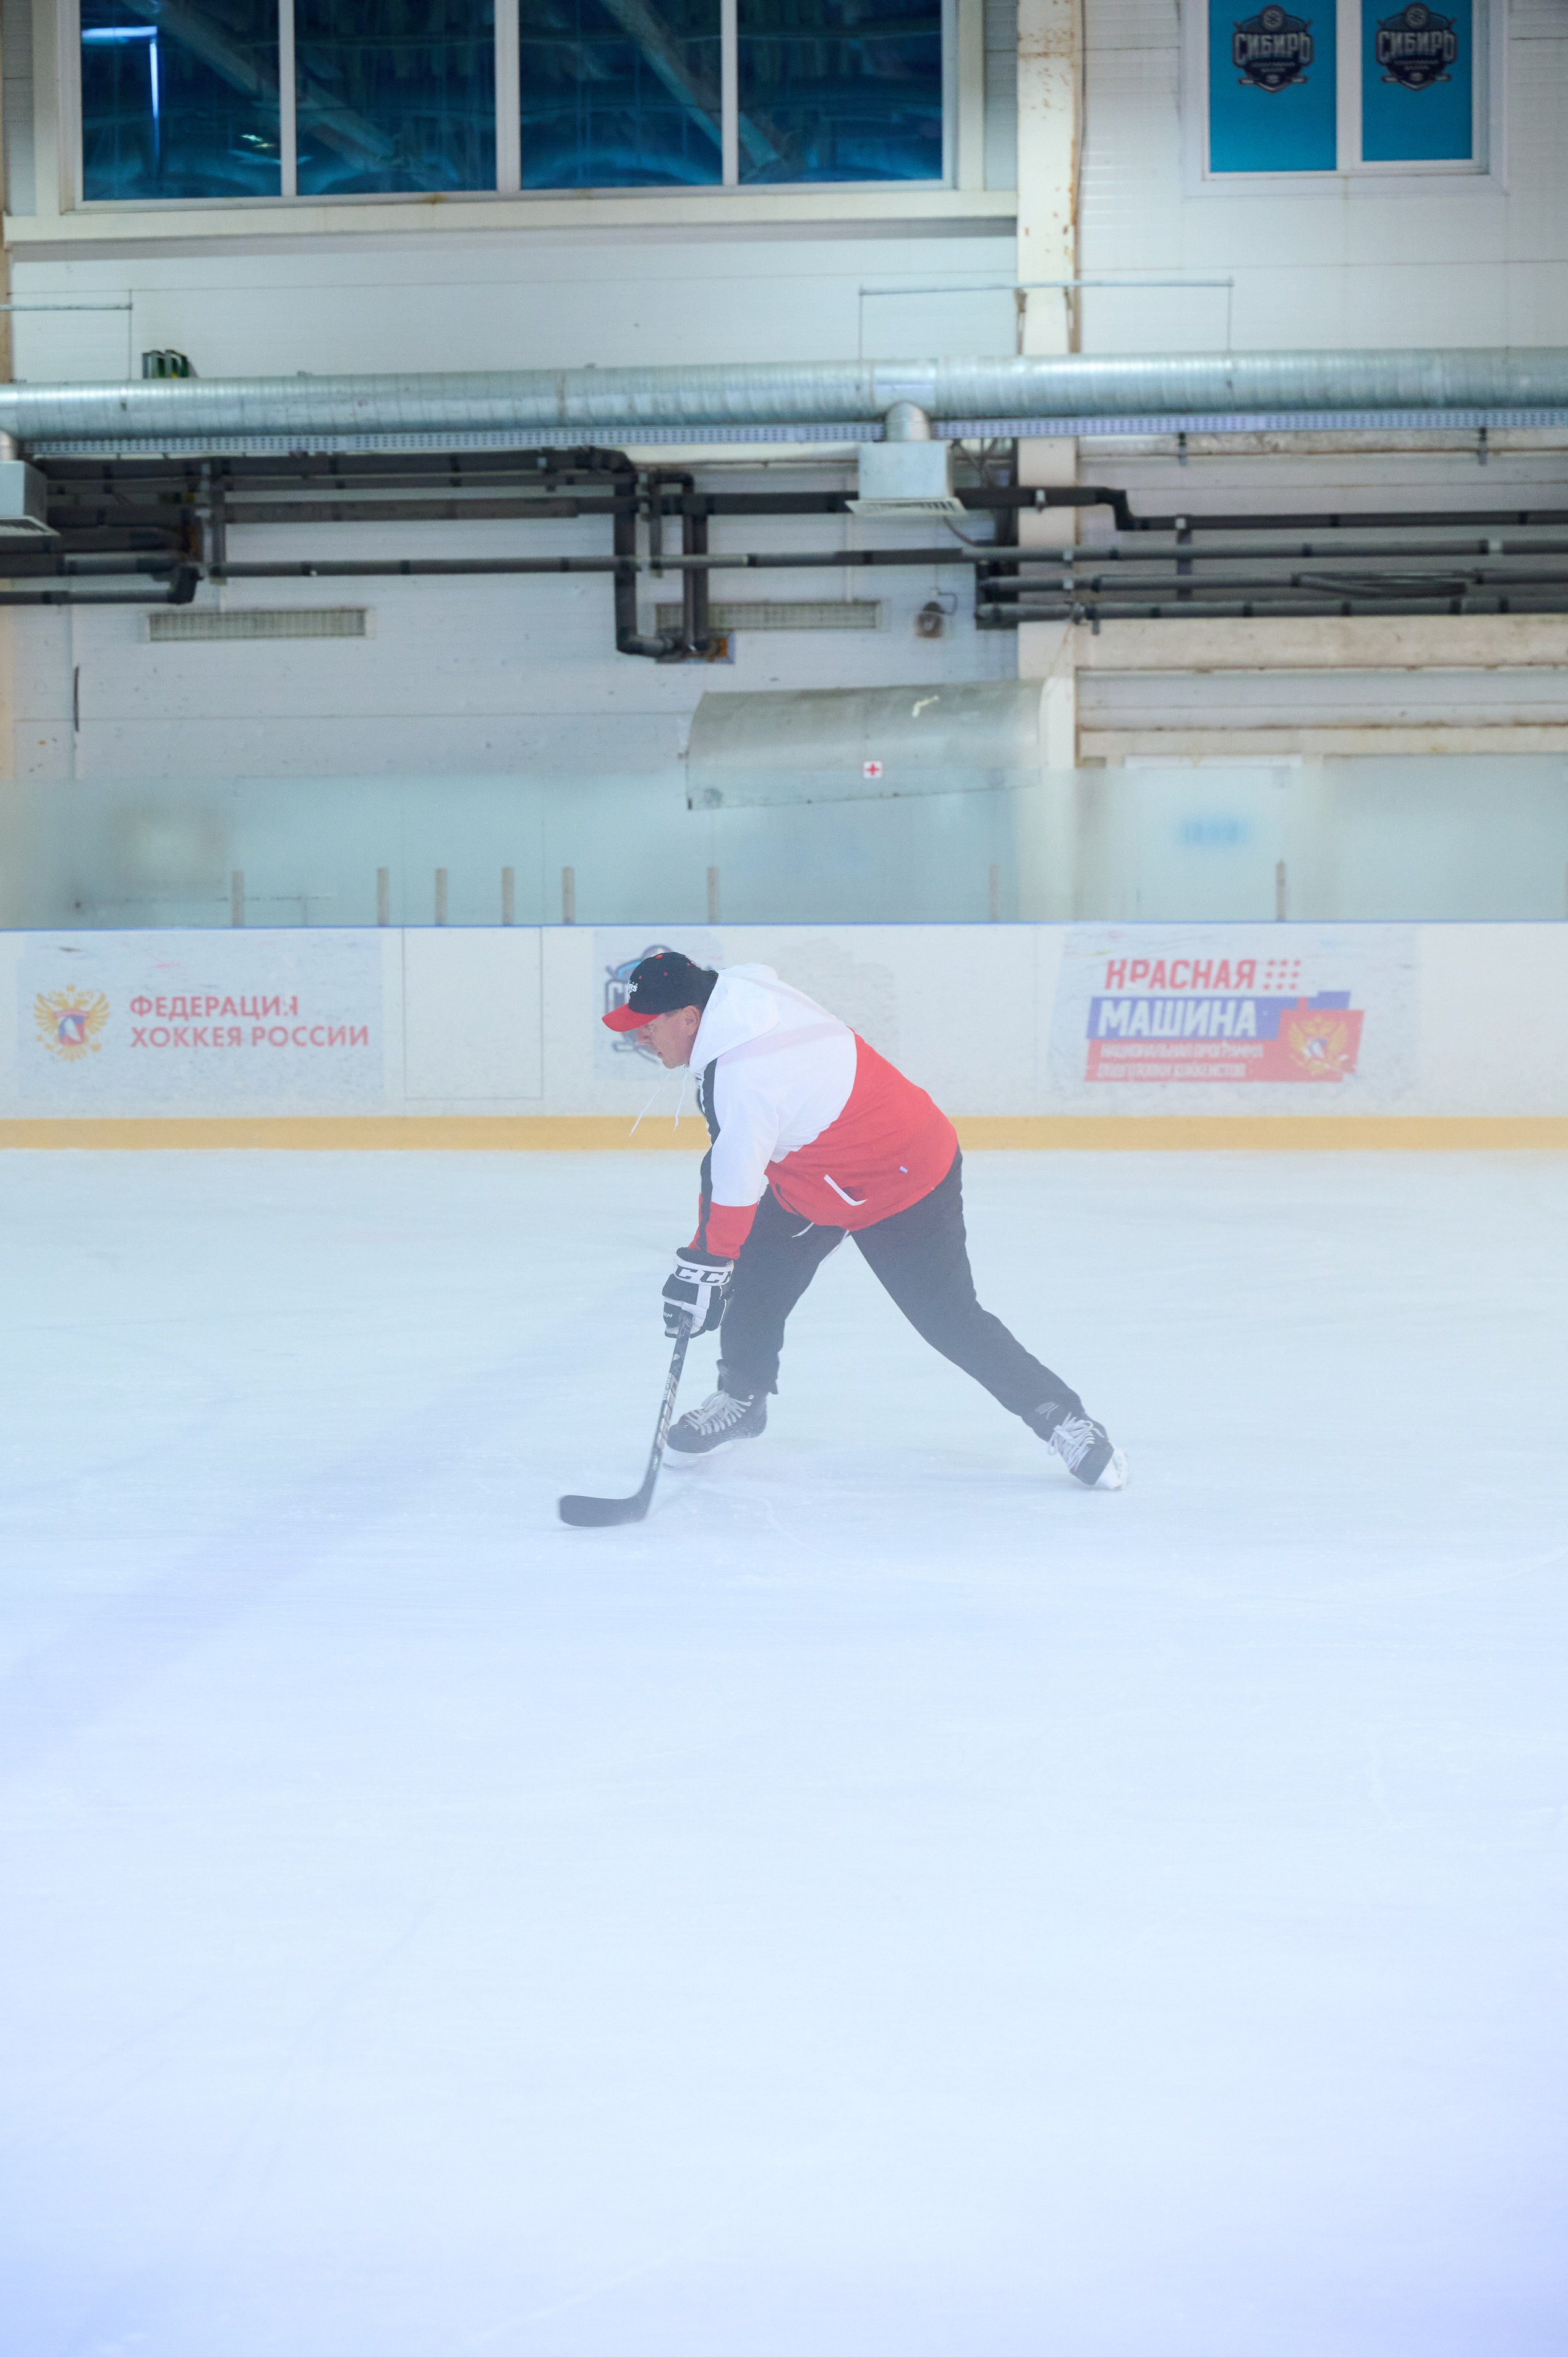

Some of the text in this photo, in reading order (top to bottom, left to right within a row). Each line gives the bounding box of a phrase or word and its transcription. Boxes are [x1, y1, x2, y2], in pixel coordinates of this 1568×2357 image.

[1234, 32, 1312, 65] СИБИРЬ
[1378, 30, 1455, 64] СИБИРЬ
[1103, 959, 1257, 990] КРАСНАЯ
[1097, 1000, 1257, 1037] МАШИНА
[130, 1025, 369, 1047] ХОККЕЯ РОССИИ
